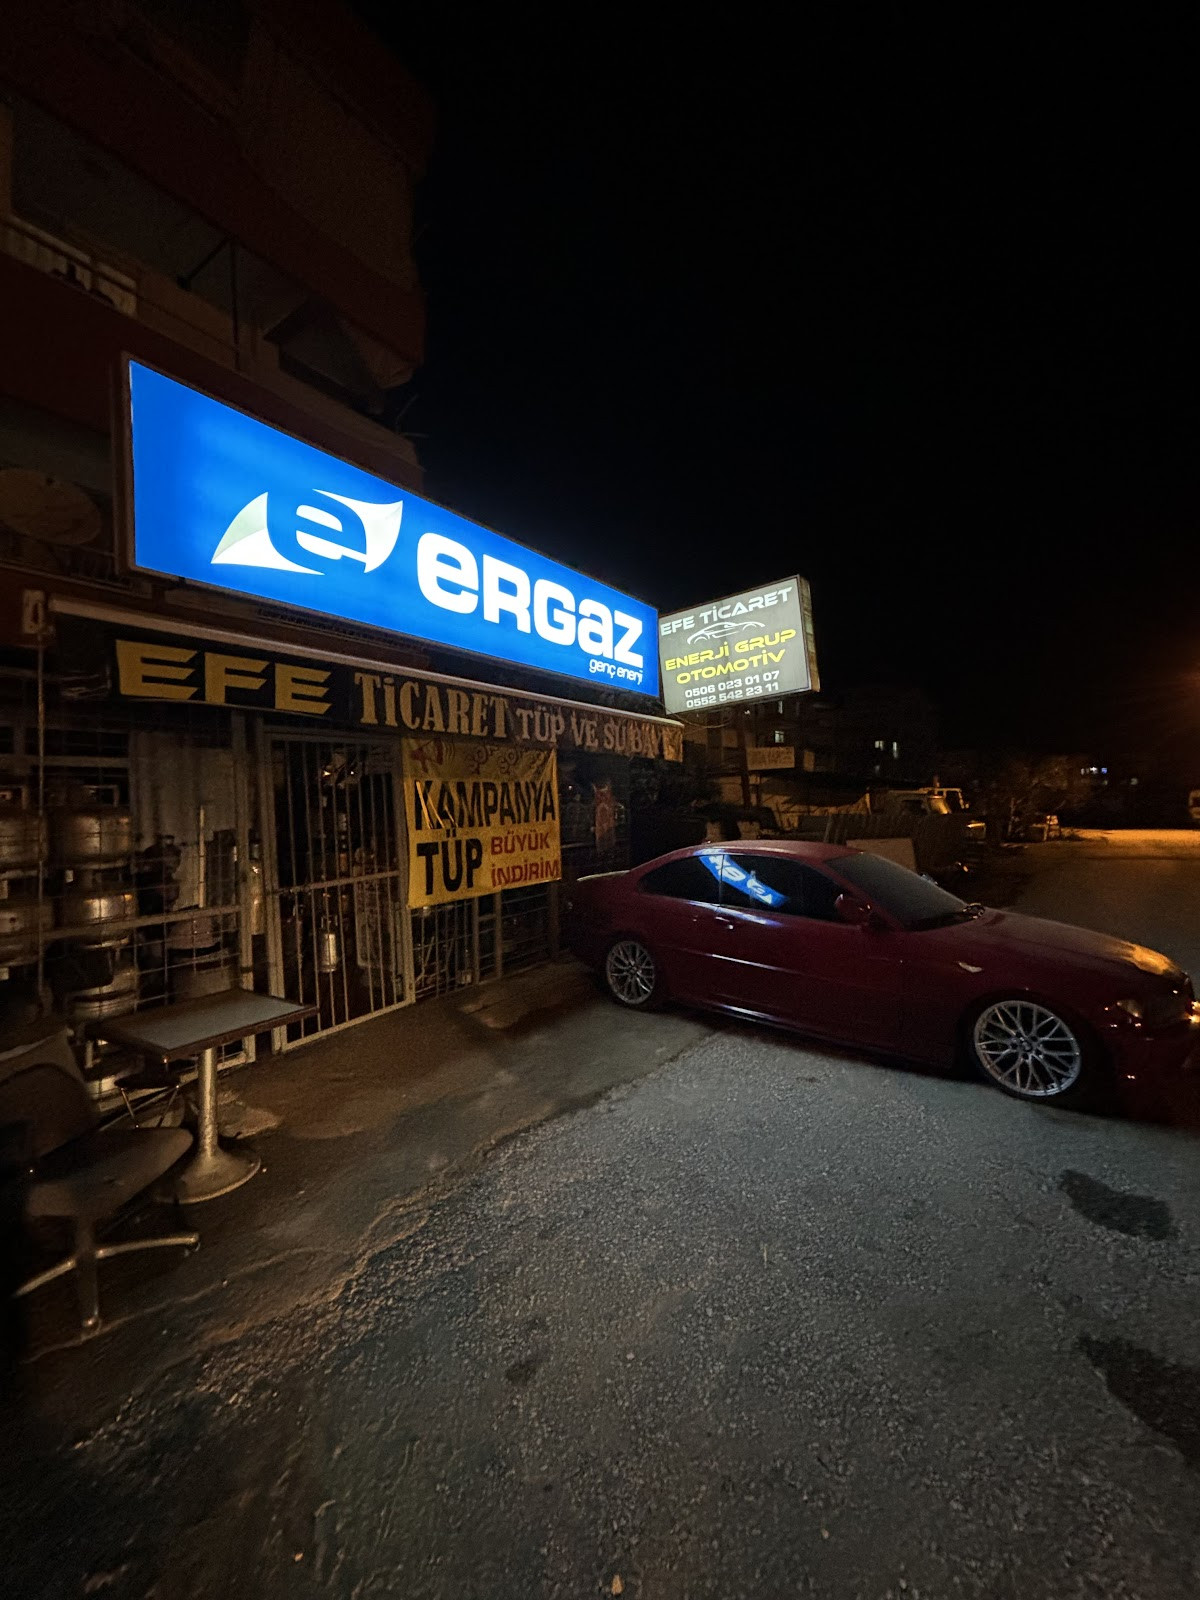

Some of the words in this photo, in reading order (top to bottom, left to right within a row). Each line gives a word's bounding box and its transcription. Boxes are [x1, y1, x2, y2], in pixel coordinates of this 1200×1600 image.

[660, 615, 696, 636] EFE
[699, 587, 793, 625] TİCARET
[665, 641, 730, 671] ENERJİ
[734, 629, 797, 654] GRUP
[676, 649, 786, 685] OTOMOTİV
[589, 659, 616, 679] genç
[685, 684, 716, 699] 0506
[718, 678, 743, 692] 023
[745, 674, 760, 686] 01
[763, 670, 780, 682] 07
[116, 638, 334, 716] EFE
[354, 672, 510, 740] TİCARET
[516, 704, 566, 743] TÜP
[571, 711, 599, 751] VE
[686, 695, 717, 709] 0552
[719, 691, 744, 702] 542
[746, 686, 763, 697] 23
[765, 682, 779, 693] 11
[415, 780, 555, 830] KAMPANYA
[491, 829, 550, 855] BÜYÜK
[417, 826, 483, 895] TÜP
[491, 856, 559, 887] İNDİRİM
